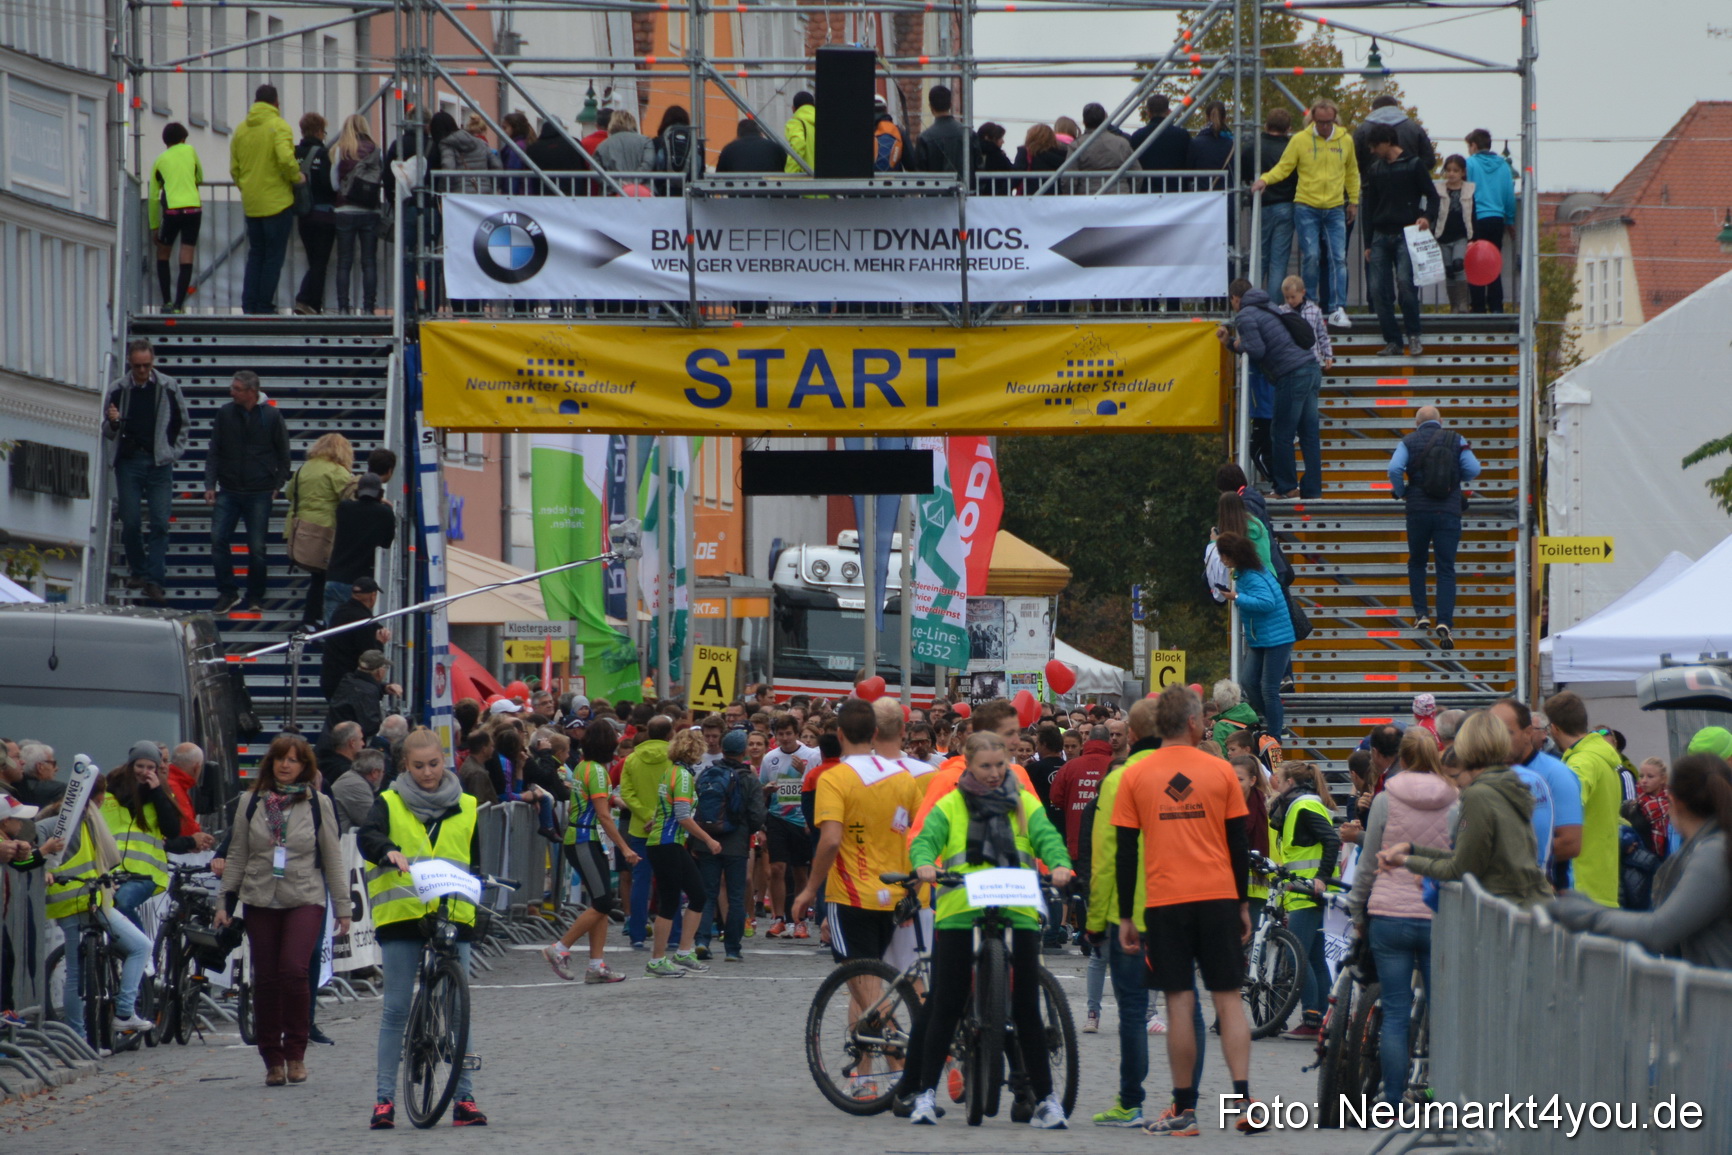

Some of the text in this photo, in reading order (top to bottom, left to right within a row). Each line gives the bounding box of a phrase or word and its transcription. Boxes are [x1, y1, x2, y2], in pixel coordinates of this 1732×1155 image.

[481, 212, 543, 236] BMW
[651, 228, 1029, 251] BMW EFFICIENTDYNAMICS.
[652, 258, 732, 272] WENGER
[736, 258, 850, 273] VERBRAUCH.
[854, 257, 904, 272] MEHR
[684, 348, 956, 409] START
[465, 377, 636, 396] Neumarkter Stadtlauf
[1006, 378, 1175, 395] Neumarkter Stadtlauf
[1539, 543, 1601, 557] Toiletten
[508, 622, 562, 635] Klostergasse
[698, 649, 733, 664] Block
[1155, 652, 1182, 663] Block
[699, 667, 724, 698] A
[1158, 665, 1177, 690] C
[64, 779, 80, 808] BMW
[780, 784, 803, 795] 5082
[420, 872, 473, 884] Erster Mann
[418, 880, 479, 895] Schnupperlauf
[1005, 882, 1026, 890] Frau
[971, 892, 1037, 900] Schnupperlauf
